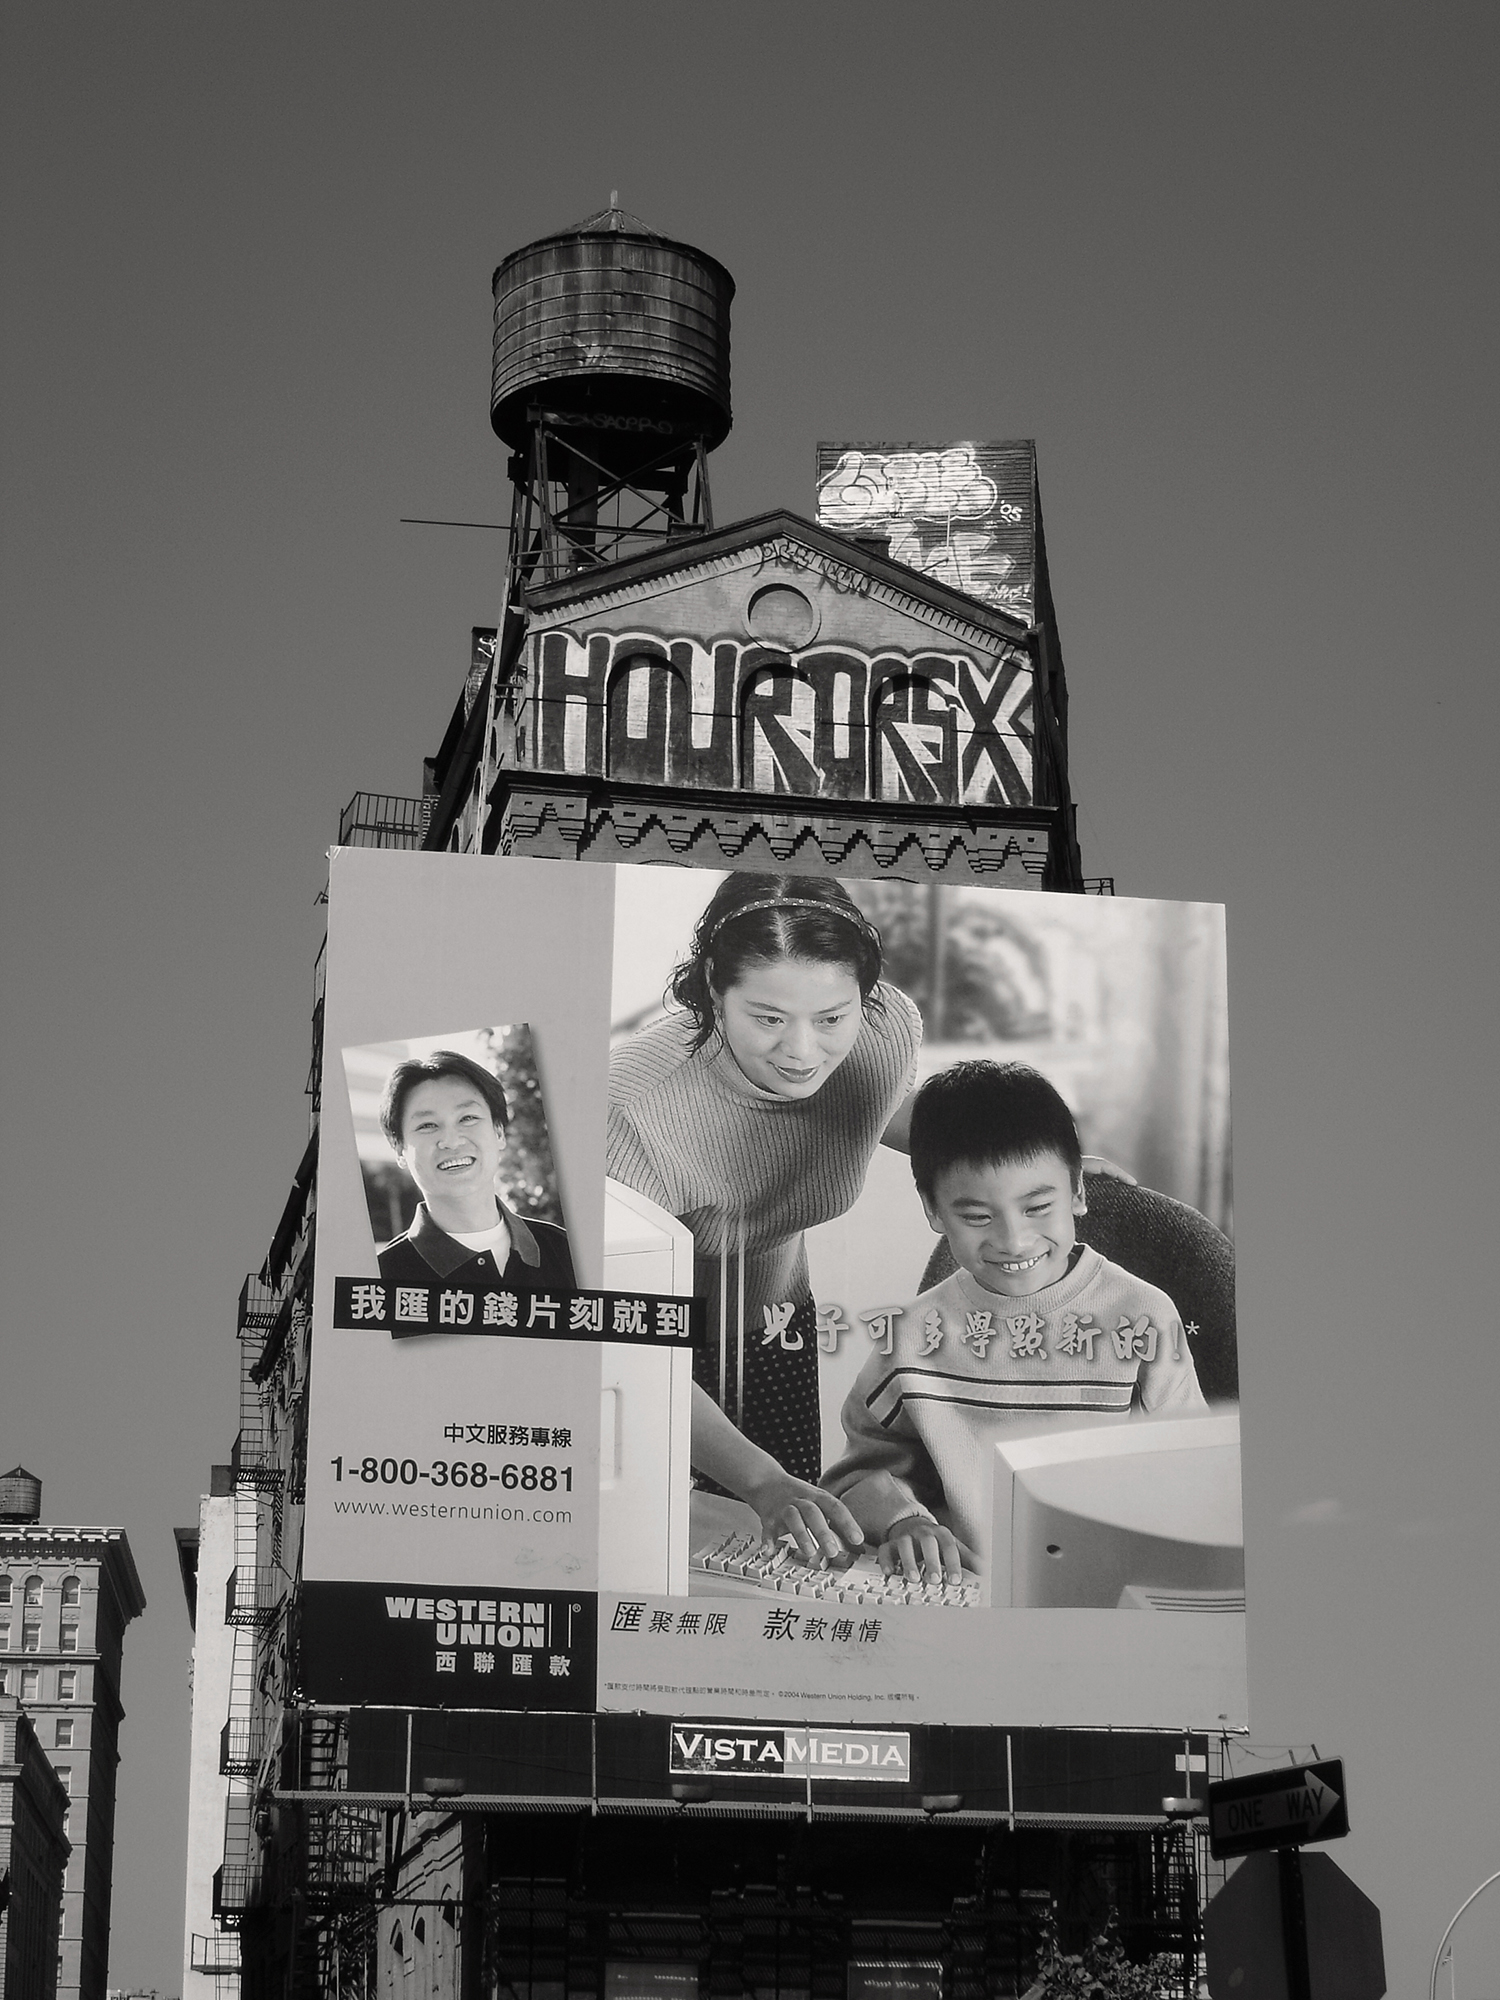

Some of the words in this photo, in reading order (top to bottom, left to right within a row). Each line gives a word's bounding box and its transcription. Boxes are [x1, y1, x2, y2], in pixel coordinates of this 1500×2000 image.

[350, 1284, 691, 1339] 我匯的錢片刻就到
[443, 1423, 573, 1448] 中文服務專線
[330, 1456, 574, 1492] 1-800-368-6881
[334, 1500, 573, 1524] www.westernunion.com
[385, 1596, 546, 1624] WESTERN
[610, 1601, 728, 1636] 匯聚無限
[762, 1607, 883, 1643] 款款傳情
[436, 1623, 545, 1648] UNION
[435, 1650, 571, 1677] 西聯匯款
[800, 1691, 827, 1700] Western
[828, 1692, 847, 1701] Union
[1227, 1799, 1265, 1832] ONE
[1285, 1786, 1324, 1820] WAY
